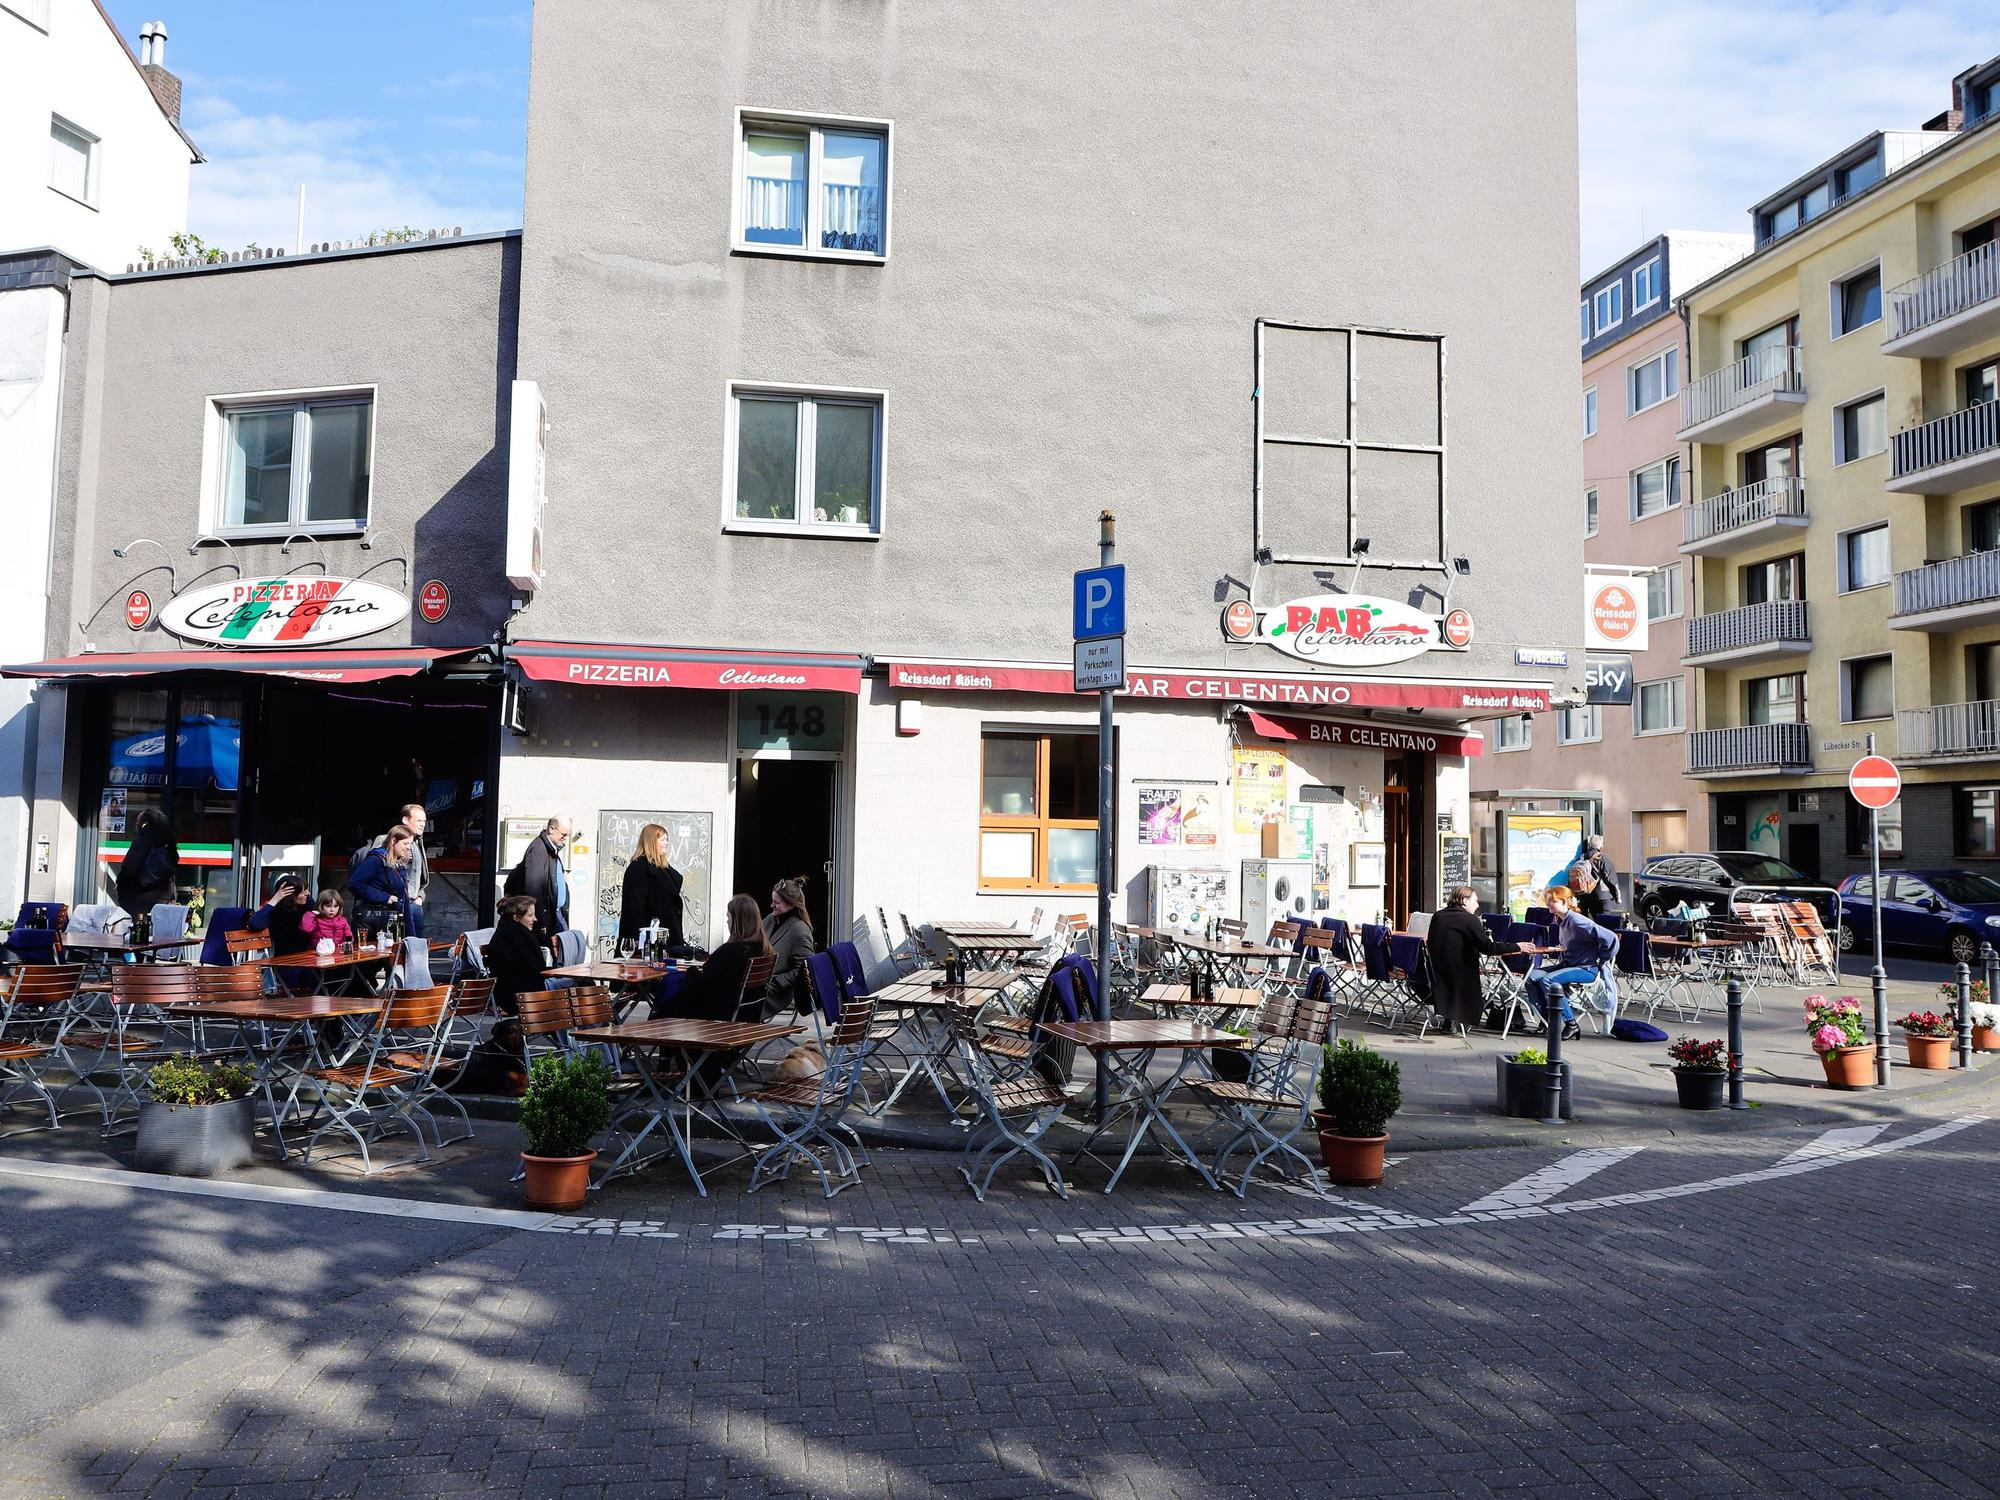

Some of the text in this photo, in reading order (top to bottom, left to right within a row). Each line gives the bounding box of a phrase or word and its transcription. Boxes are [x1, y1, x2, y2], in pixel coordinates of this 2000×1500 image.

[233, 582, 333, 603] PIZZERIA
[1085, 577, 1113, 629] P
[184, 597, 380, 630] Celentano
[1286, 605, 1372, 637] BAR
[1594, 607, 1636, 619] Reissdorf
[1603, 620, 1630, 632] Kölsch
[1293, 622, 1428, 656] Celentano
[1087, 645, 1109, 656] nur mit
[568, 663, 807, 685] PIZZERIA Celentano
[1084, 658, 1113, 671] Parkschein
[898, 671, 992, 689] Reissdorf Kölsch
[1077, 674, 1102, 686] werktags
[1586, 663, 1627, 692] sky
[1185, 679, 1351, 704] CELENTANO
[1462, 694, 1544, 710] Reissdorf Kölsch
[757, 704, 826, 737] 148
[1310, 723, 1437, 752] BAR CELENTANO
[1824, 741, 1850, 751] Lübecker
